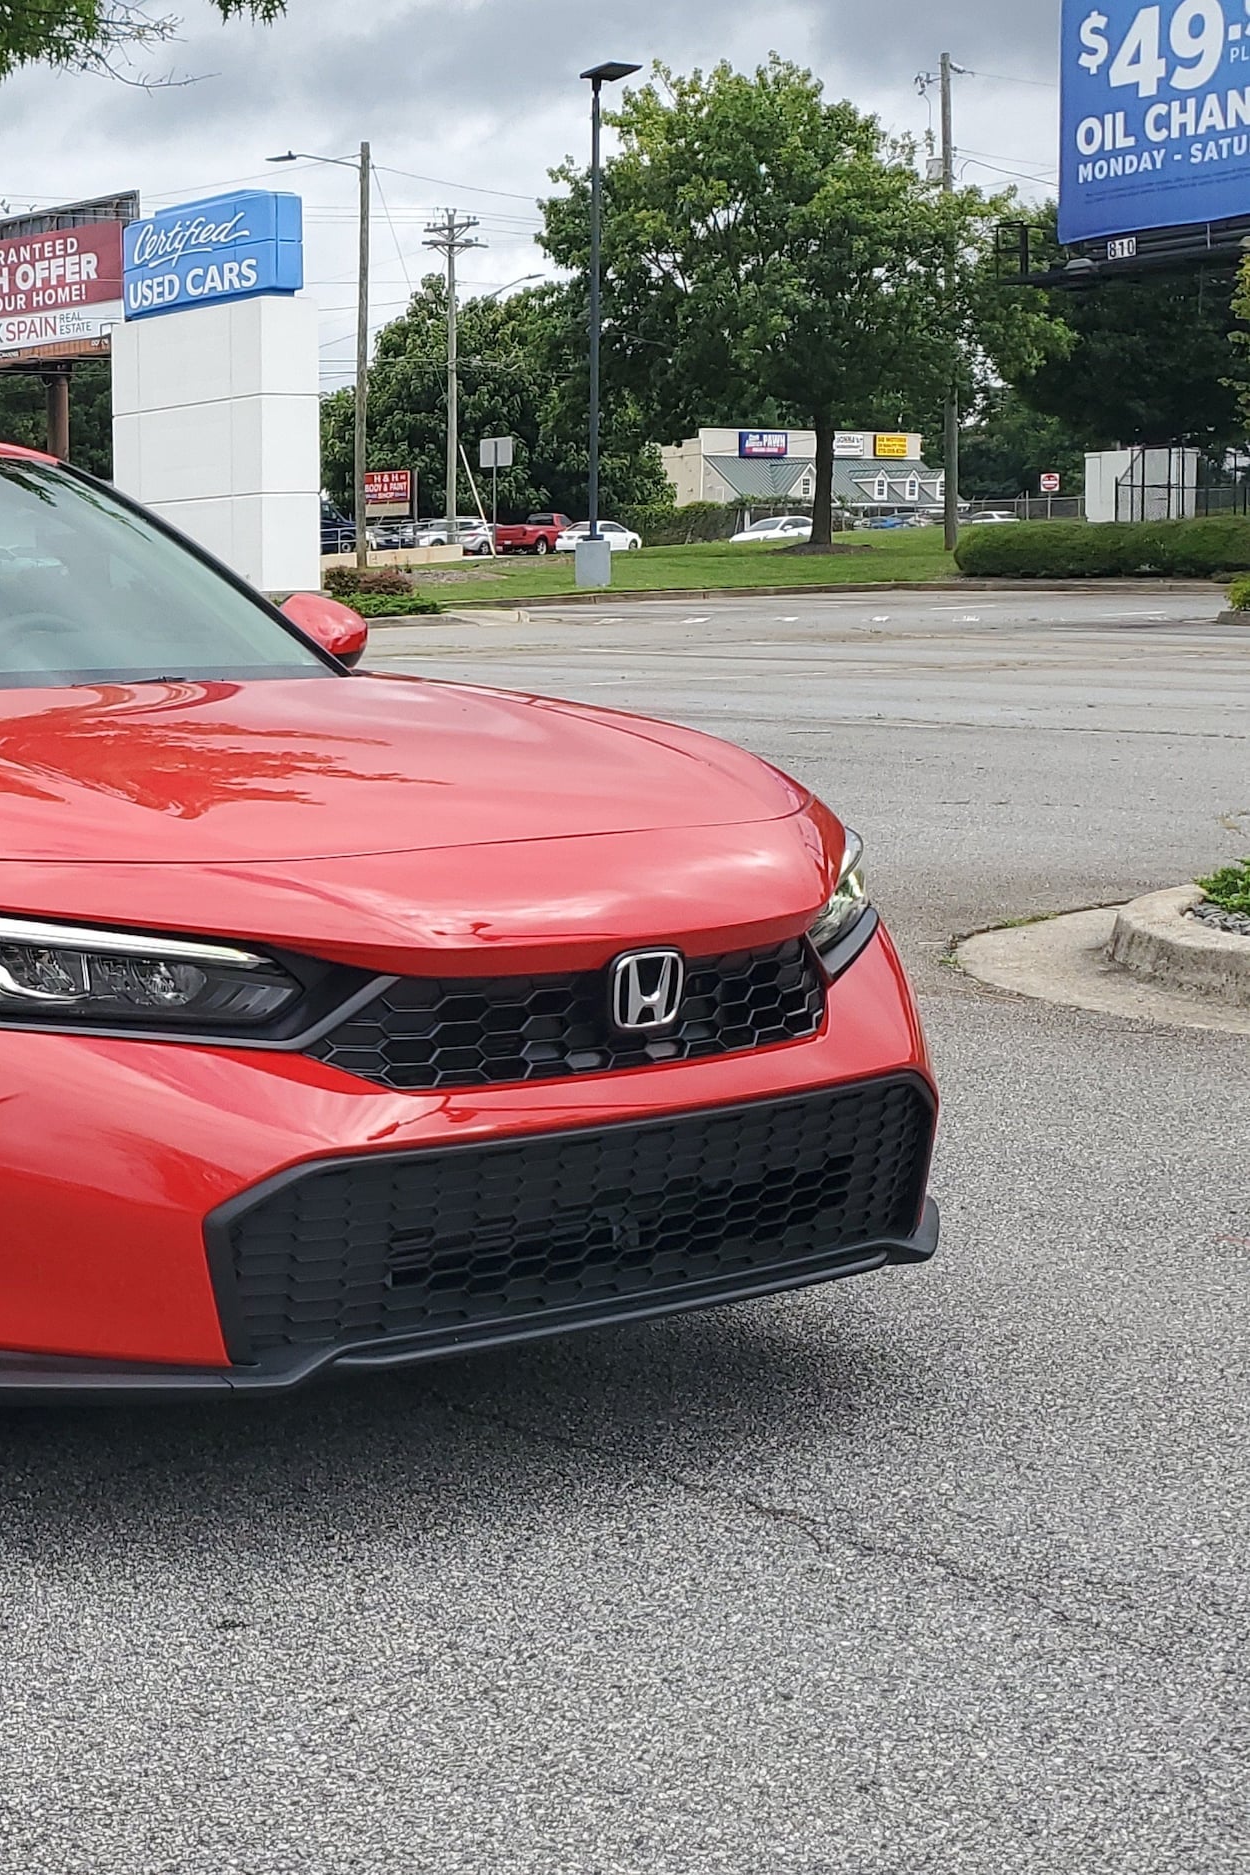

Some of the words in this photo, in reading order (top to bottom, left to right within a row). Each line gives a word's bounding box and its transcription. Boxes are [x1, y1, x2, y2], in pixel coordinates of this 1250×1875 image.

[1076, 111, 1136, 156] OIL
[1144, 86, 1250, 143] CHAN
[1078, 149, 1166, 184] MONDAY
[1190, 134, 1250, 164] SATU
[133, 211, 250, 268] Certified
[1108, 239, 1136, 259] 810
[15, 252, 98, 289] OFFER
[129, 273, 179, 310] USED
[185, 258, 257, 297] CARS
[32, 284, 86, 308] HOME!
[6, 315, 57, 342] SPAIN
[59, 313, 83, 323] REAL
[59, 322, 92, 335] ESTATE
